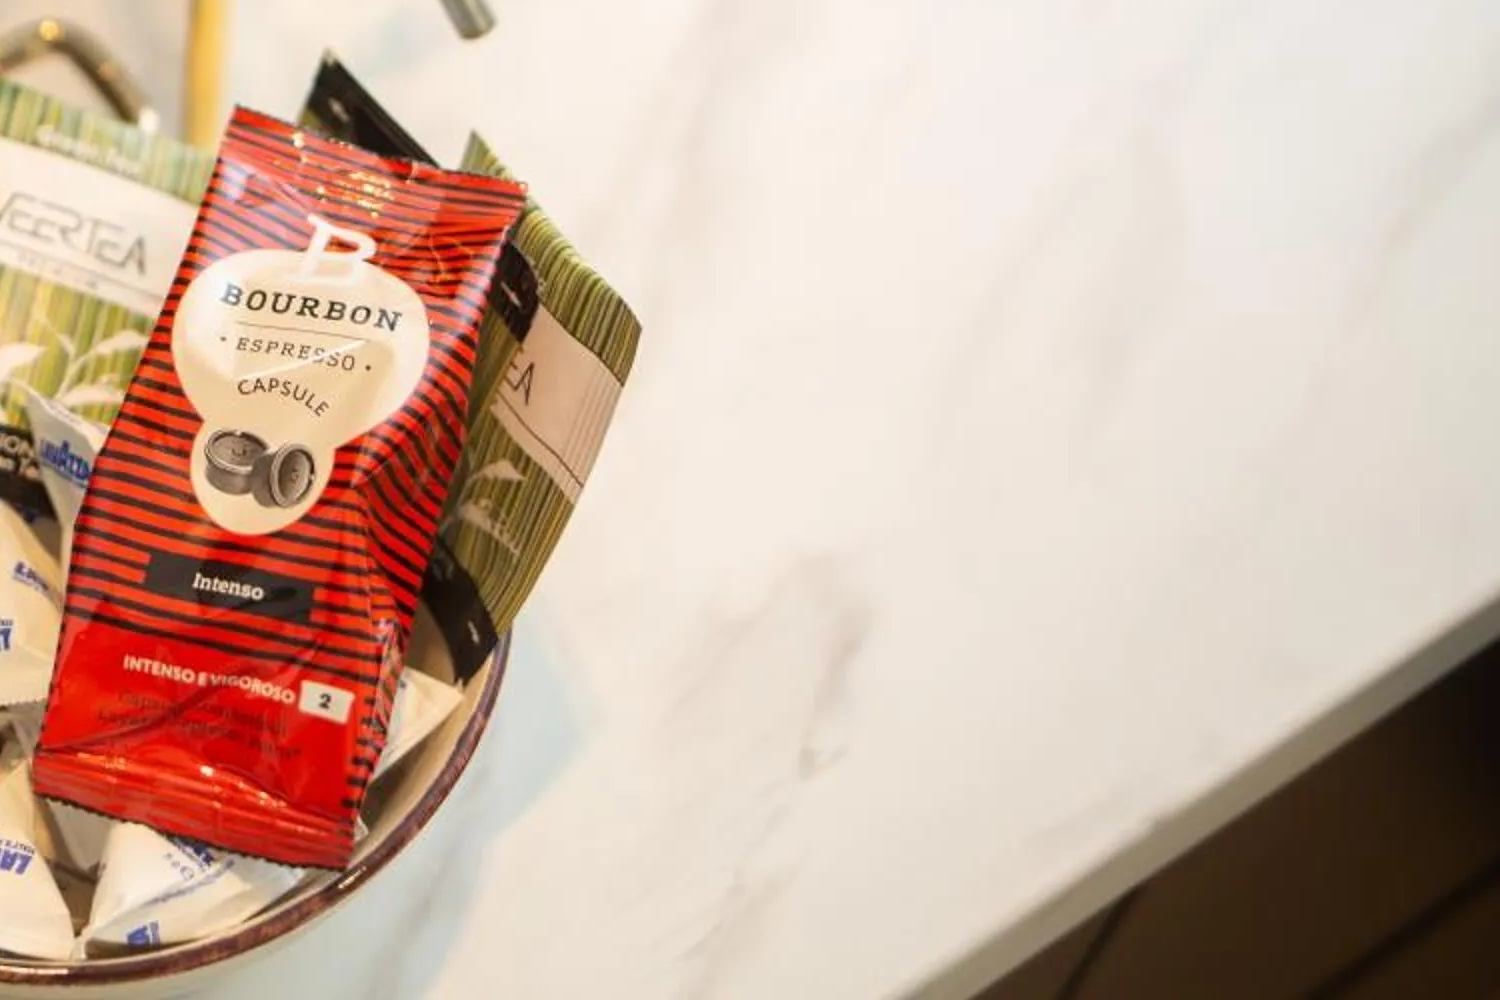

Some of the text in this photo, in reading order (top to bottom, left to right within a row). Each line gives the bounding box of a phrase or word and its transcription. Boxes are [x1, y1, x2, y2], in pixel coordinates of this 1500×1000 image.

[219, 281, 403, 333] BOURBON
[235, 336, 356, 372] ESPRESSO
[237, 378, 330, 418] CAPSULE
[192, 572, 265, 602] Intenso
[123, 653, 297, 705] INTENSO E VIGOROSO
[317, 692, 332, 710] 2
